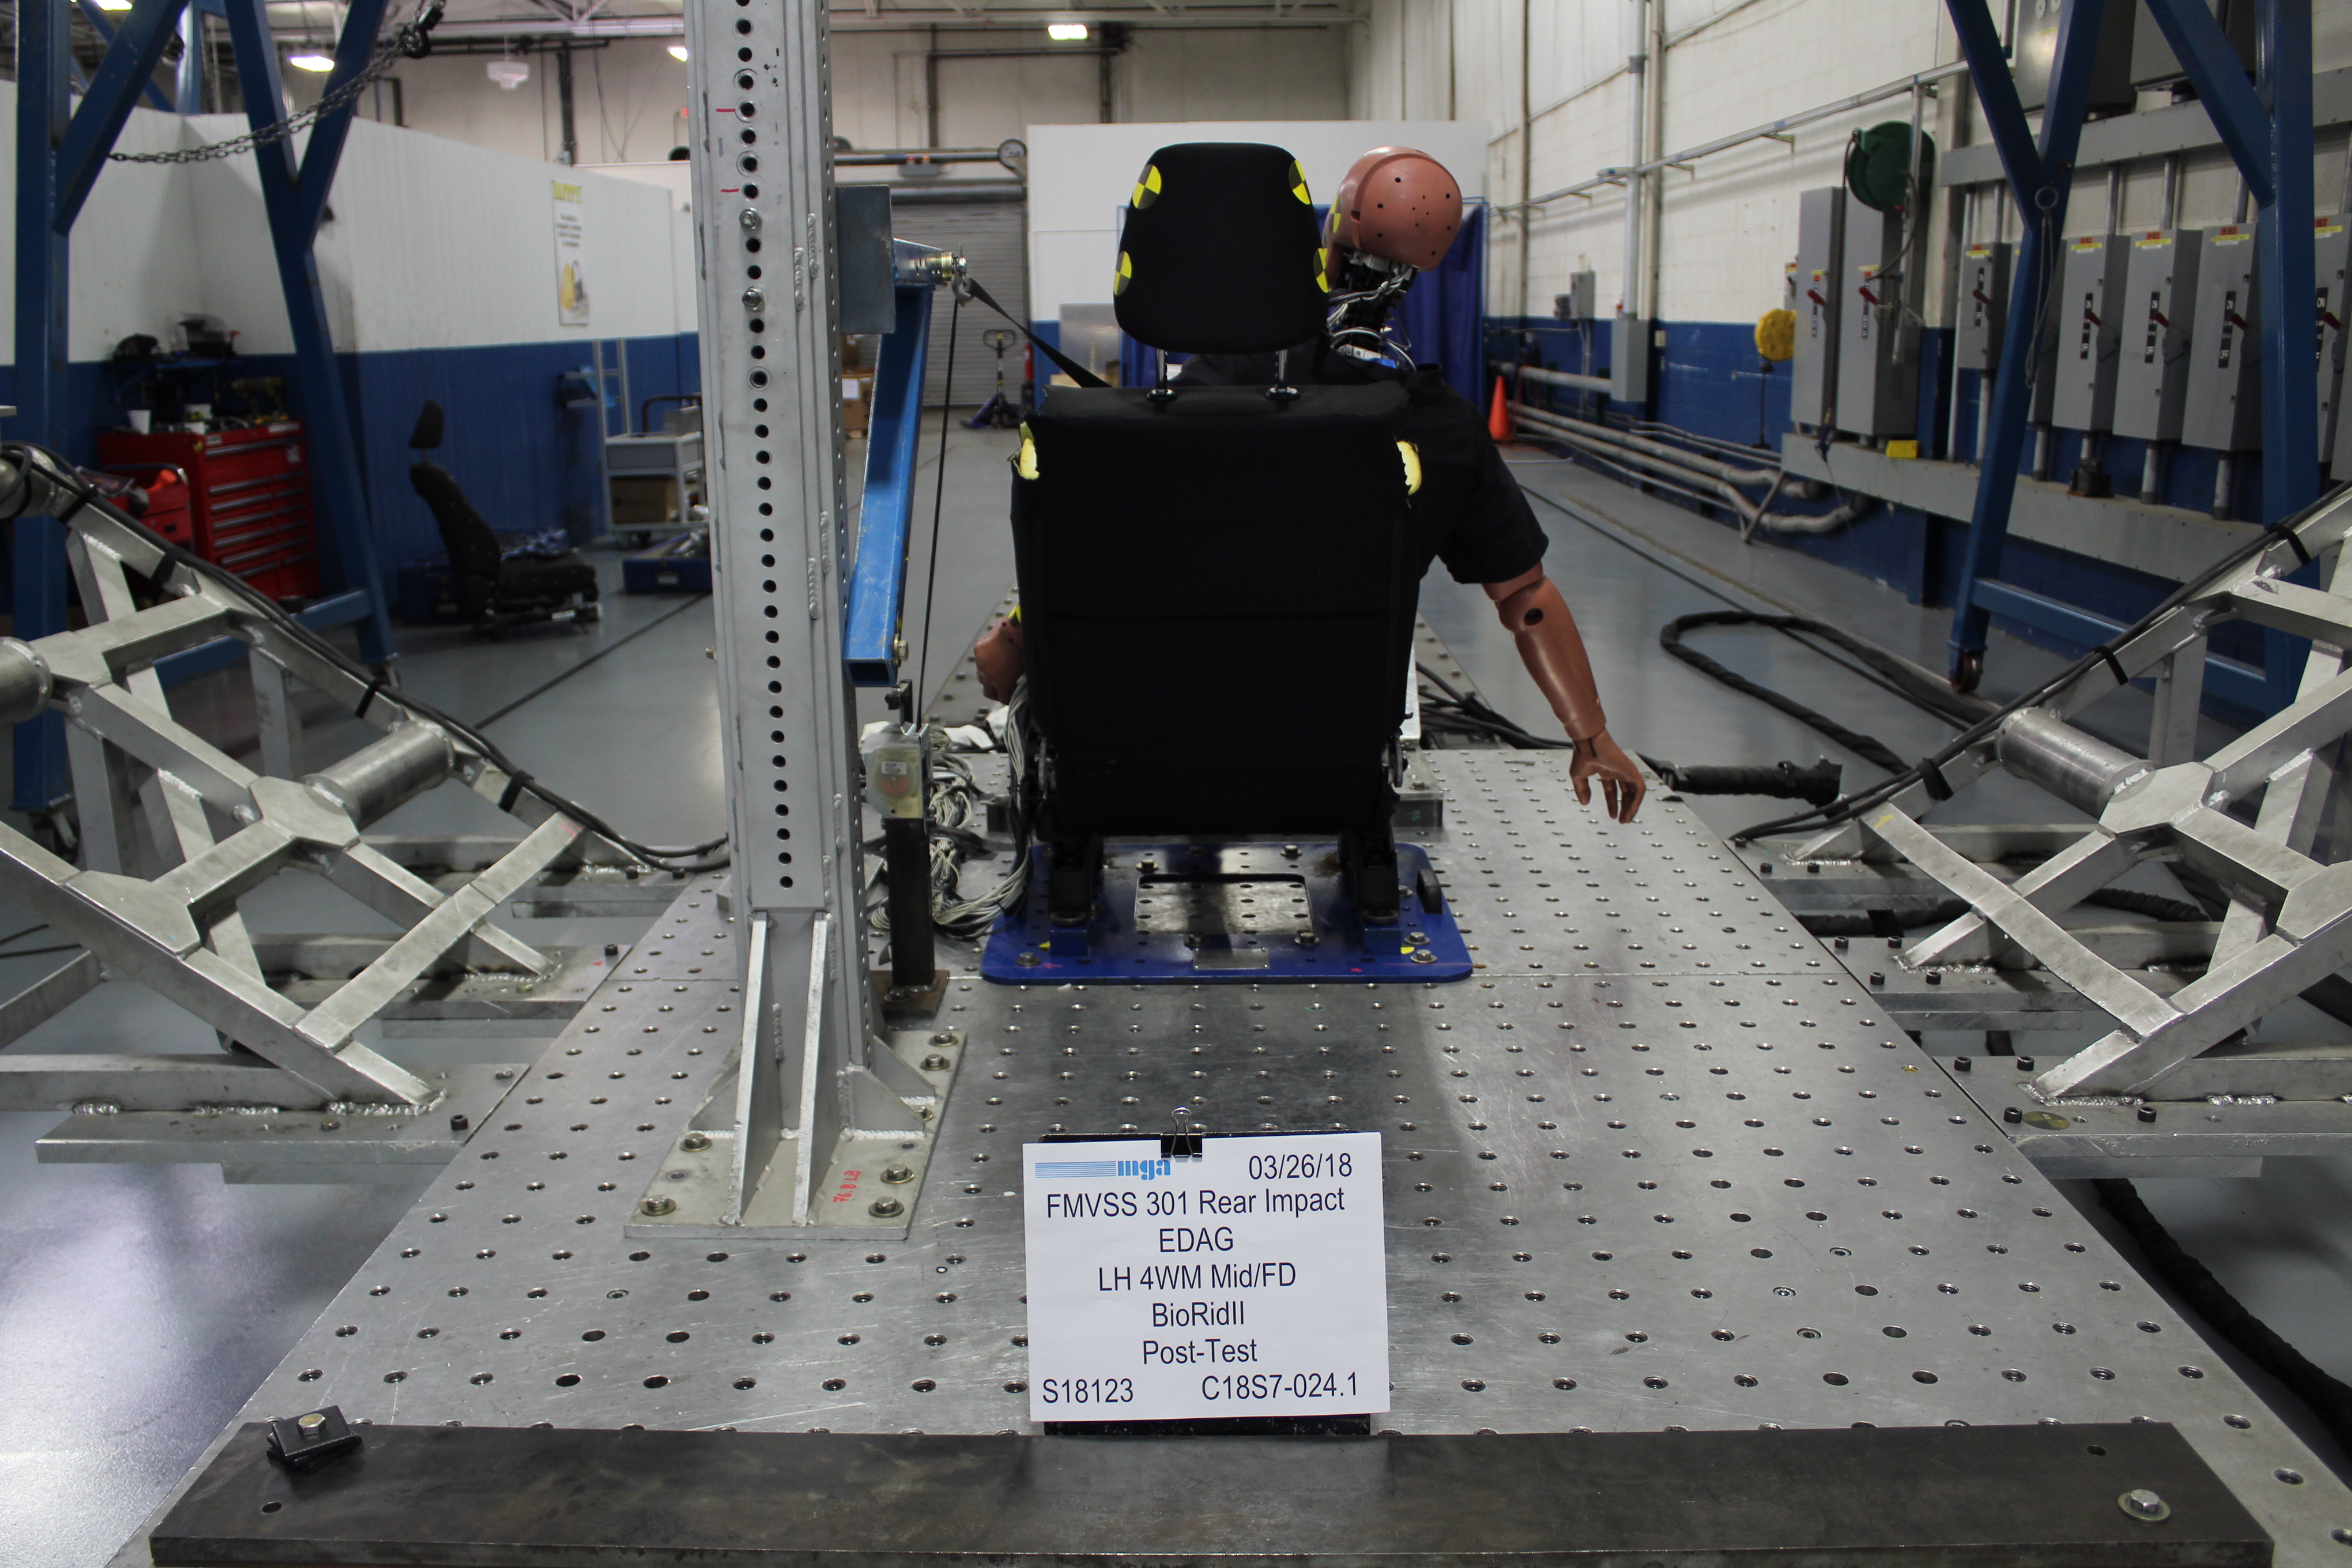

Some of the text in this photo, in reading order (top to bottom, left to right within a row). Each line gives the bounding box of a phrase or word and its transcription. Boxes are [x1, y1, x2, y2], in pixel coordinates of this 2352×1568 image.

[2317, 297, 2325, 308] ON
[1117, 1159, 1171, 1181] mga
[1249, 1152, 1352, 1180] 03/26/18
[1047, 1187, 1345, 1218] FMVSS 301 Rear Impact
[1159, 1226, 1234, 1253] EDAG
[1098, 1262, 1296, 1292] LH 4WM Mid/FD
[1152, 1301, 1244, 1328] BioRidII
[1143, 1338, 1258, 1365] Post-Test
[1043, 1377, 1134, 1404] S18123
[1202, 1371, 1356, 1401] C18S7-024.1
